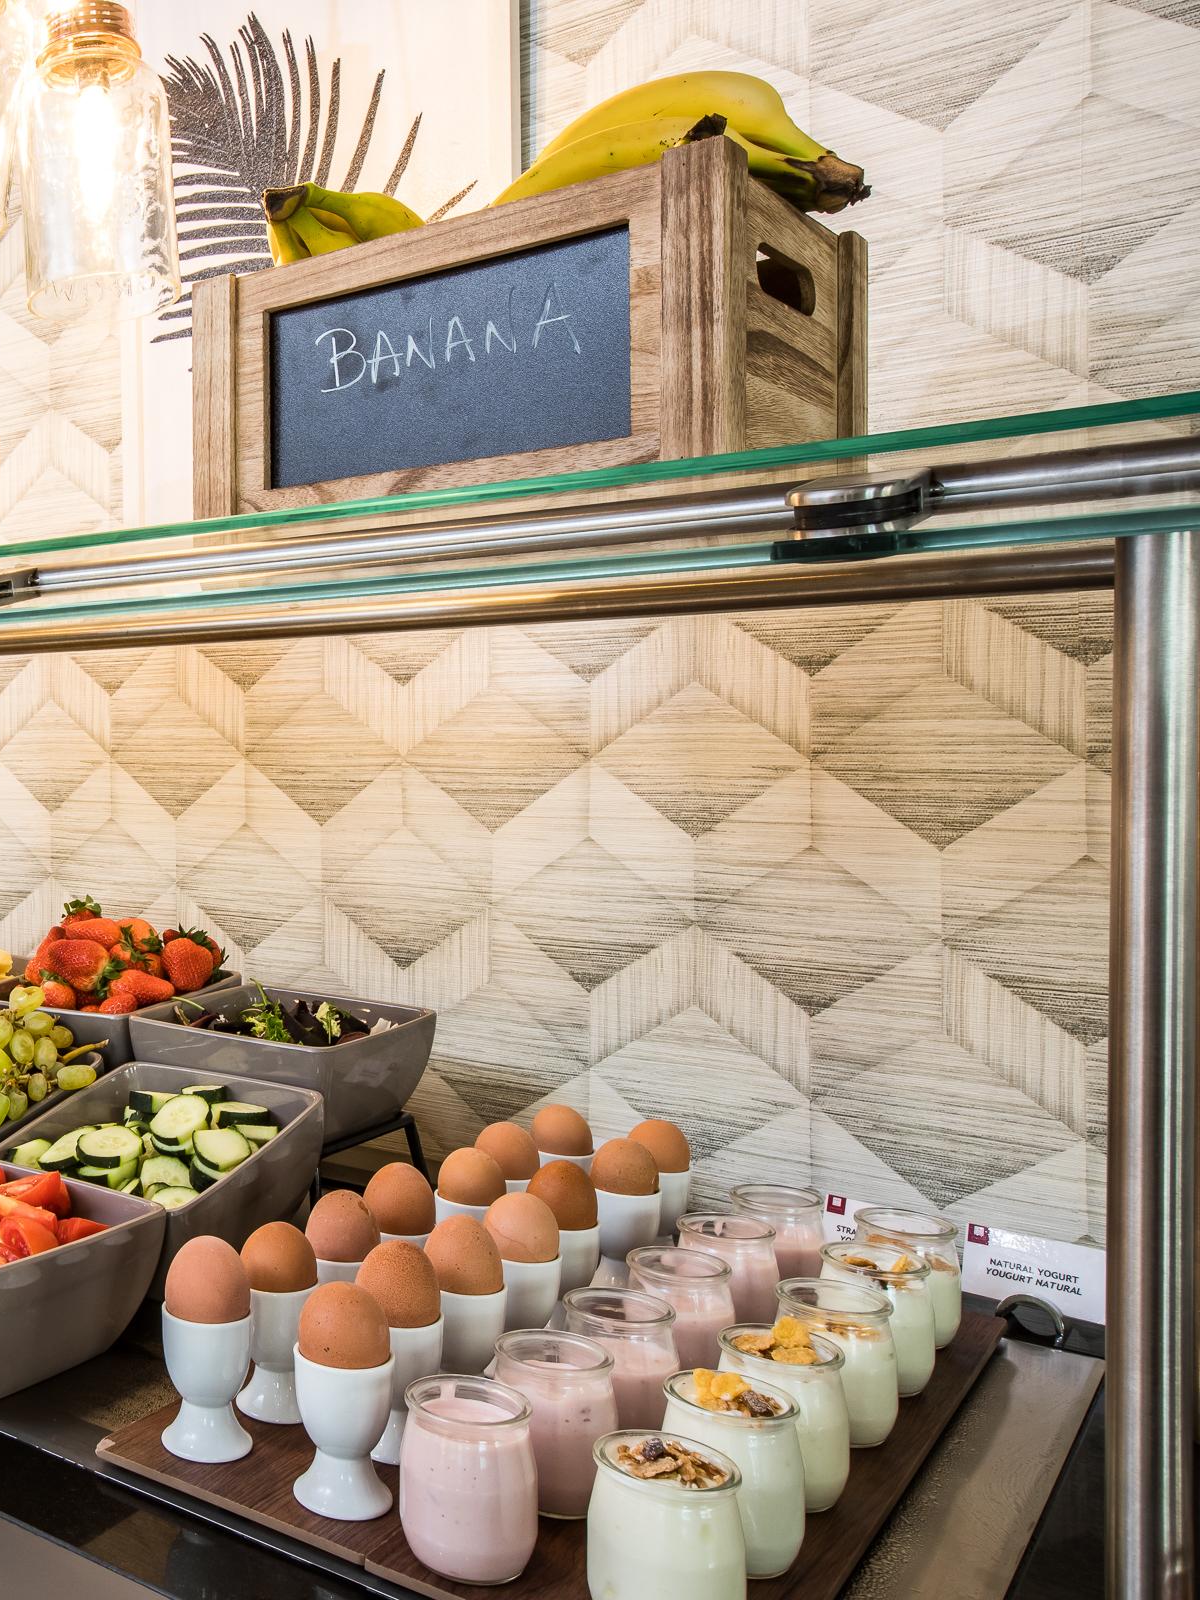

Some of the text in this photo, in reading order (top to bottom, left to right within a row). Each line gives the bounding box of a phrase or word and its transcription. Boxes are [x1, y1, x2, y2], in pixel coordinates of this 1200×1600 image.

[315, 283, 581, 393] BANANA
[836, 1224, 857, 1235] STRA
[985, 1267, 1083, 1296] YOUGURT NATURAL
[989, 1257, 1080, 1284] NATURAL YOGURT
